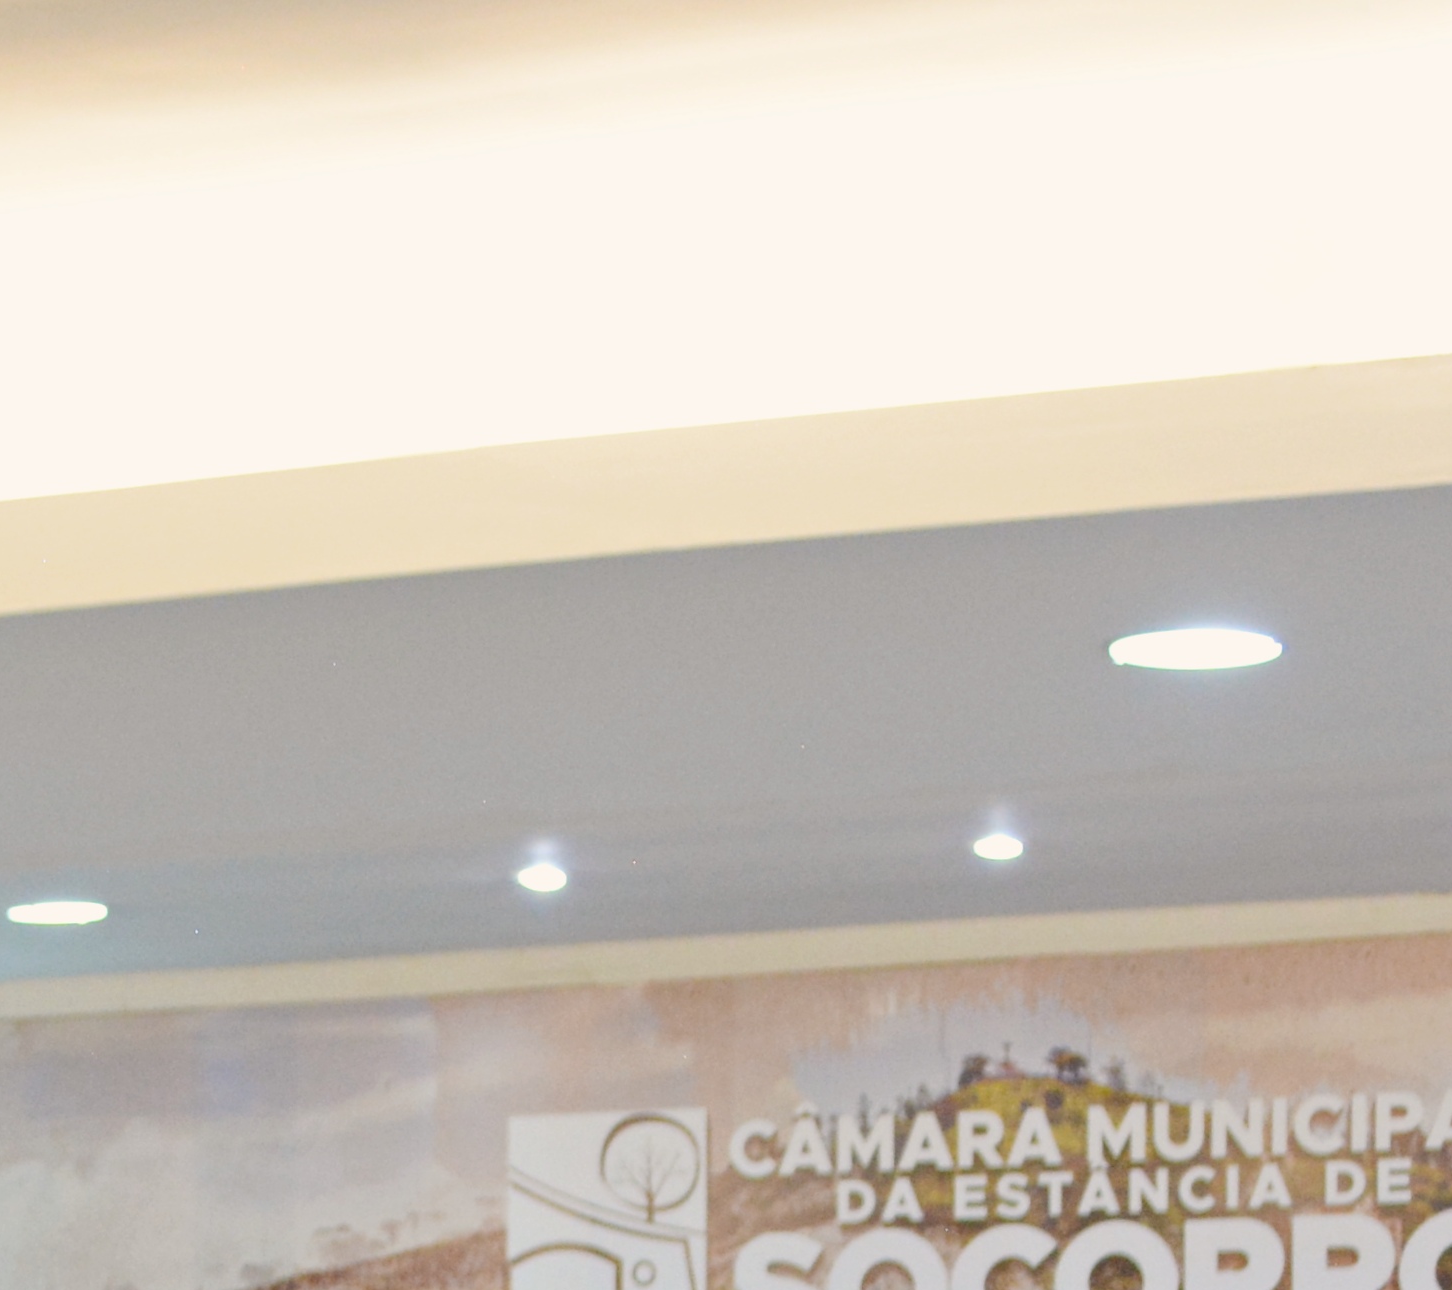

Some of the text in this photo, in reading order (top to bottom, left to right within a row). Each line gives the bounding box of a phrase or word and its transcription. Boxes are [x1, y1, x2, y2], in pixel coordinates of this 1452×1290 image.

[728, 1103, 1063, 1179] CÂMARA
[836, 1157, 1413, 1226] DA ESTÂNCIA DE
